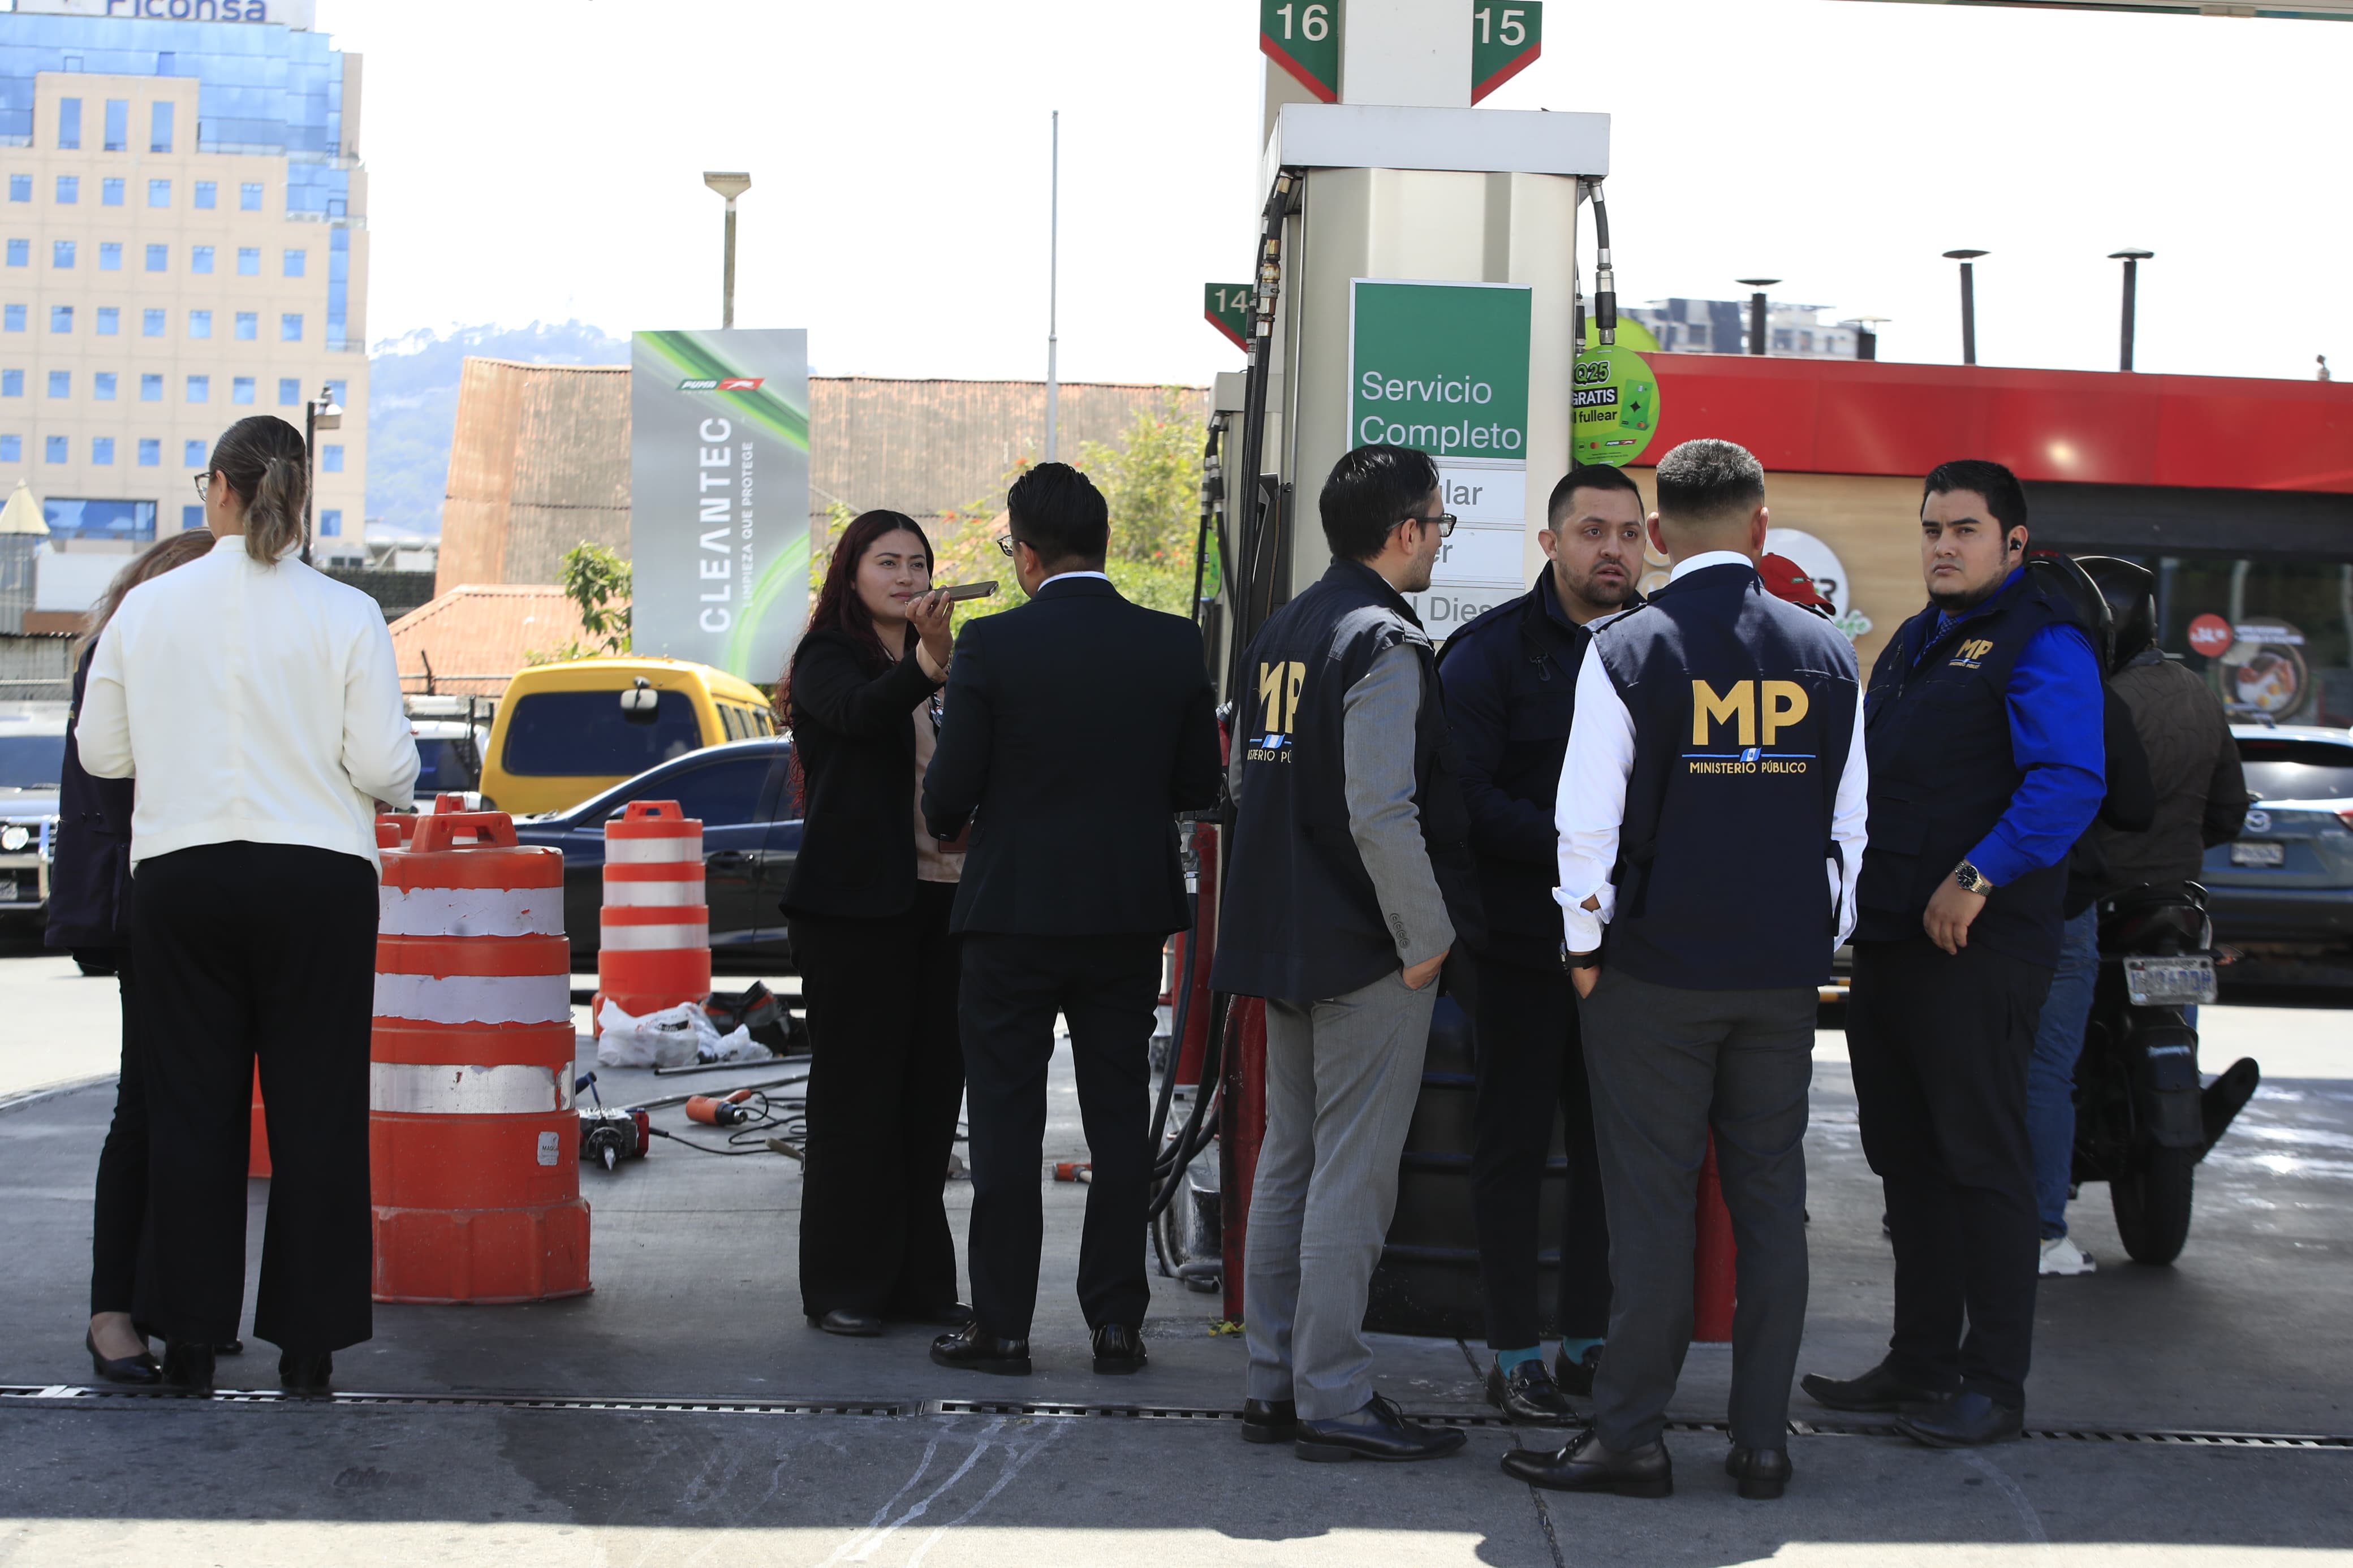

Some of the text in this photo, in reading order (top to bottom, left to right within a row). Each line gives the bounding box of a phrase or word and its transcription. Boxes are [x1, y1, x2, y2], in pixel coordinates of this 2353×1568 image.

[1277, 3, 1329, 41] 16
[1475, 7, 1525, 46] 15
[1214, 288, 1249, 313] 14
[1361, 371, 1492, 404] Servicio
[1575, 360, 1610, 386] Q25
[1573, 388, 1615, 406] GRATIS
[1579, 410, 1618, 423] fullear
[1360, 416, 1522, 454] Completo
[1440, 479, 1483, 506] lar
[699, 418, 731, 633] CLEANTEC
[742, 442, 753, 608] LIMPIEZA QUE PROTEGE
[1955, 639, 1993, 660] MP
[1259, 661, 1306, 734] MP
[1692, 680, 1809, 745] MP
[1247, 749, 1275, 761] ISTERIO
[1690, 760, 1807, 774] MINISTERIO PÚBLICO
